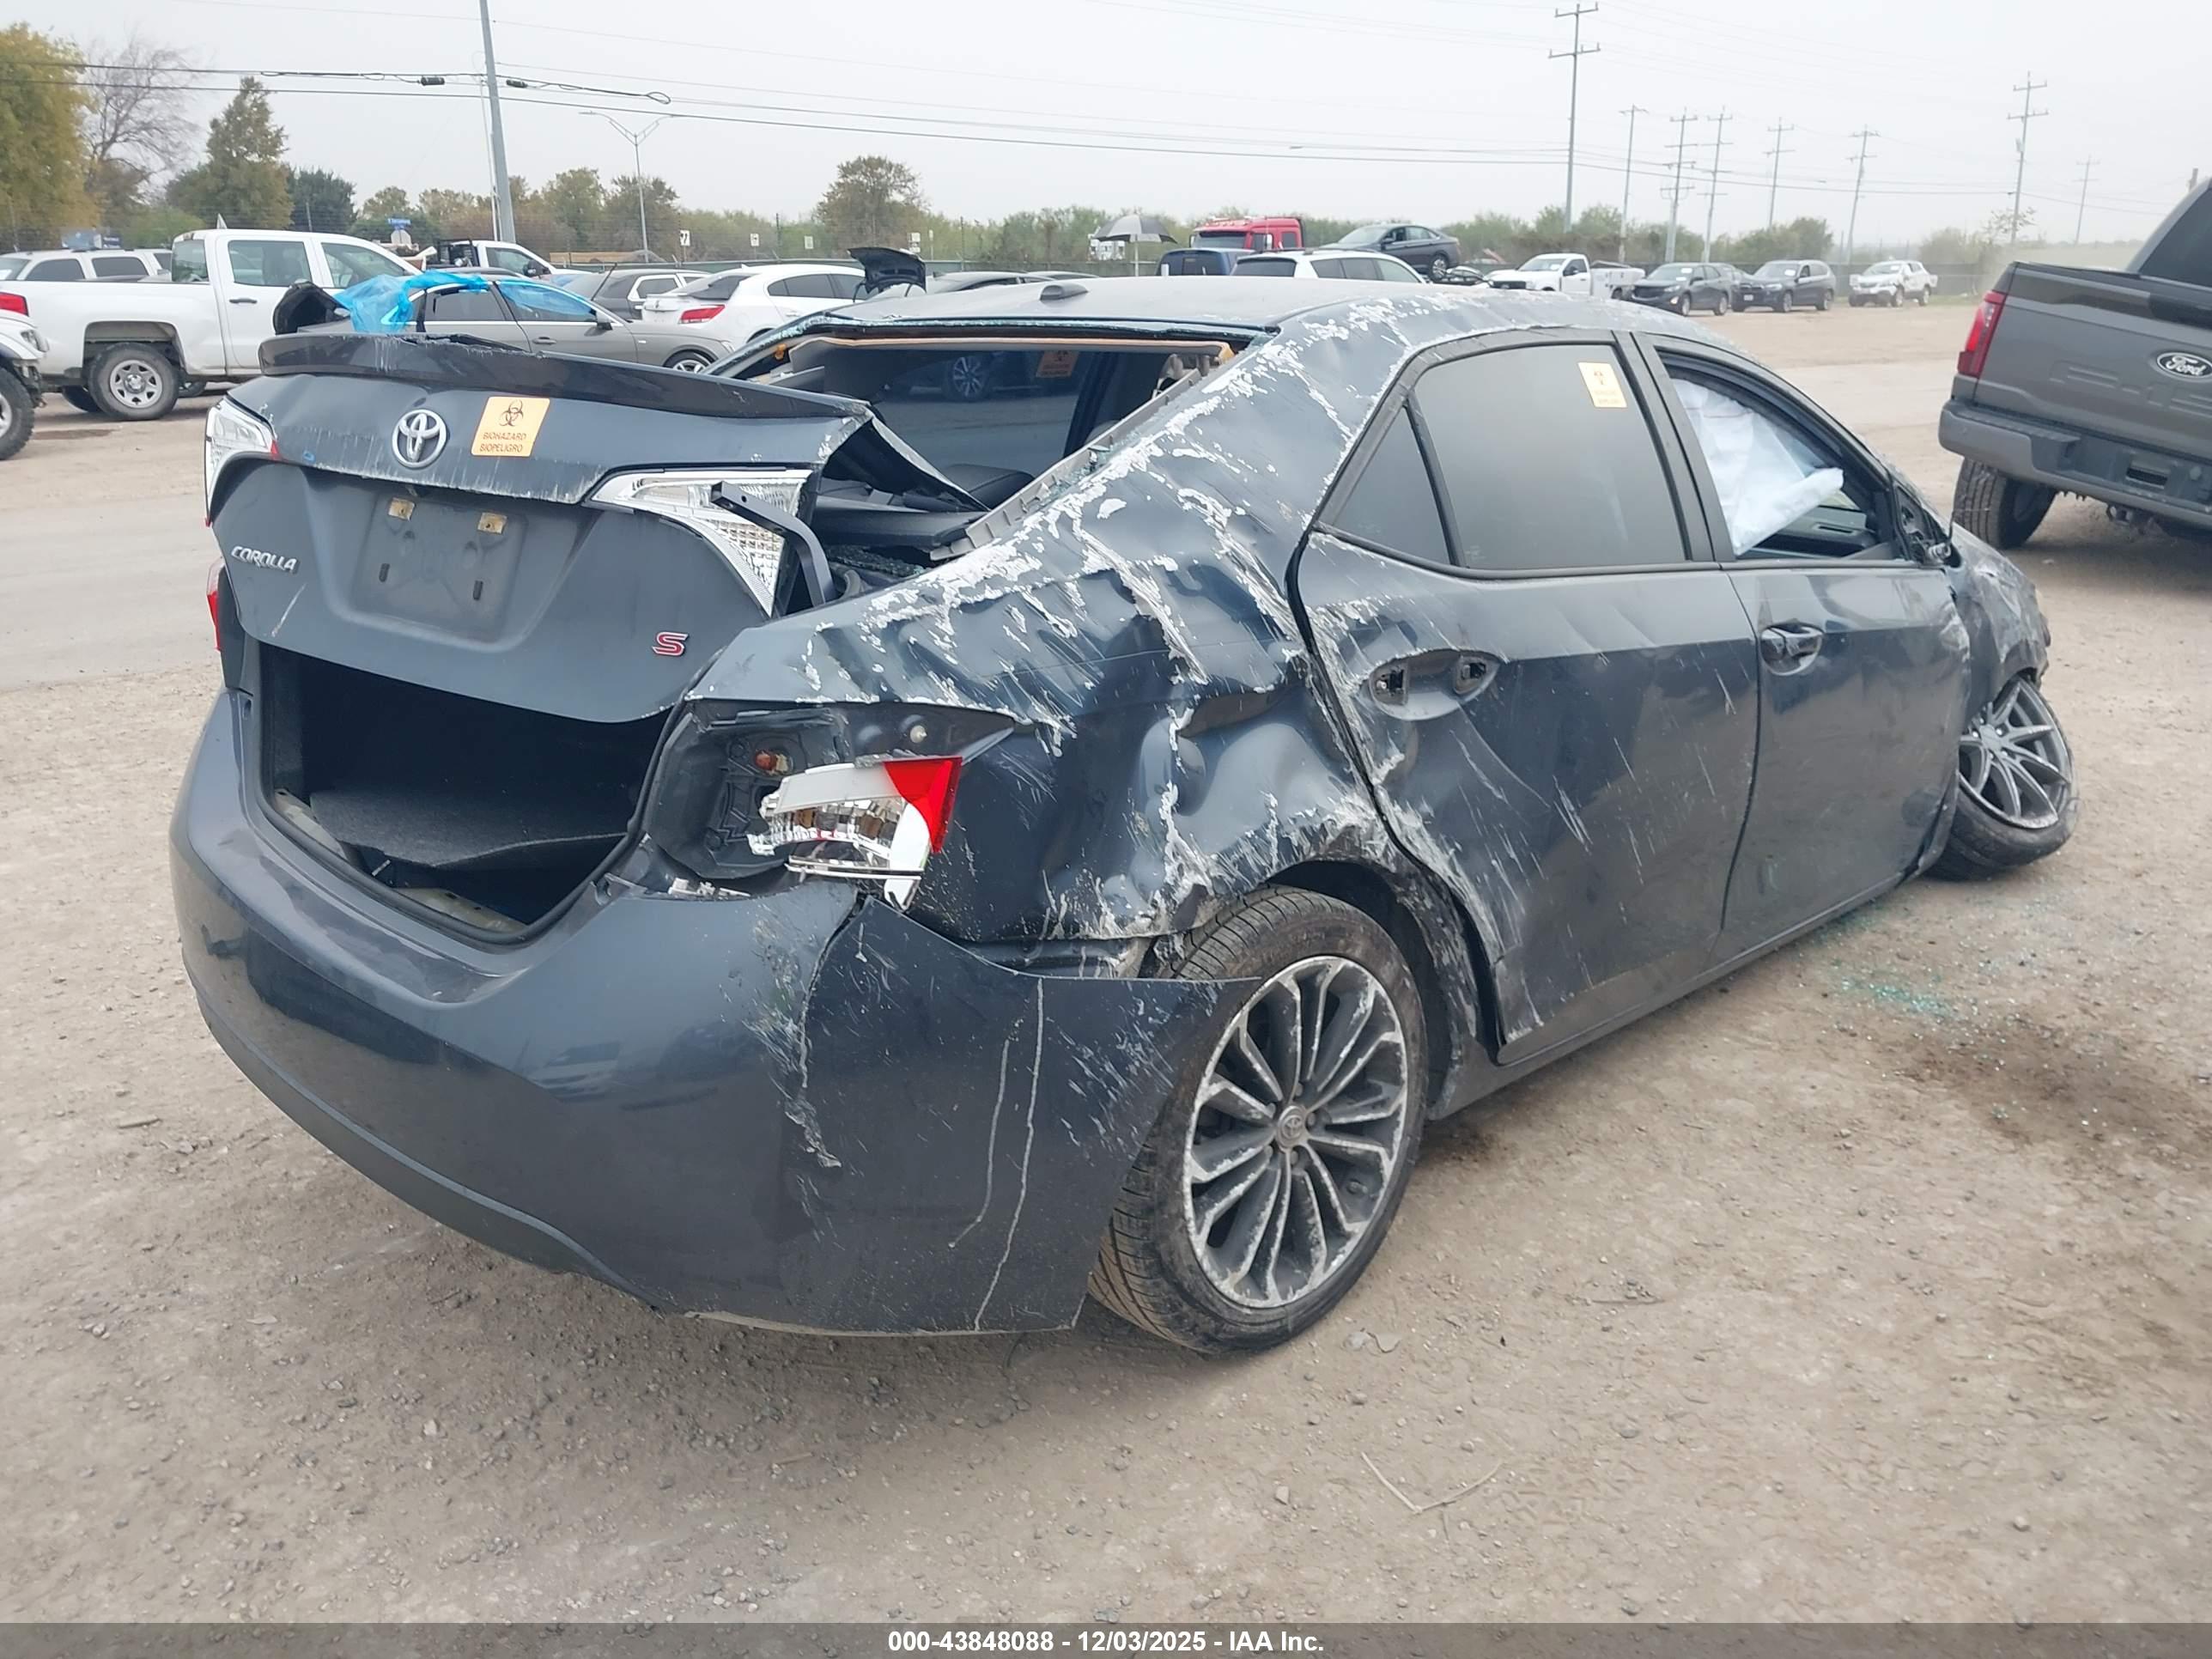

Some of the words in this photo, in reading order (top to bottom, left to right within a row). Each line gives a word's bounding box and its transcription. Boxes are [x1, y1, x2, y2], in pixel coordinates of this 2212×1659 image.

[2166, 356, 2207, 375] Ford
[483, 432, 527, 441] BIOHAZARD
[480, 443, 523, 453] BIOPELIGRO
[231, 545, 298, 571] COROLLA
[652, 631, 688, 656] S
